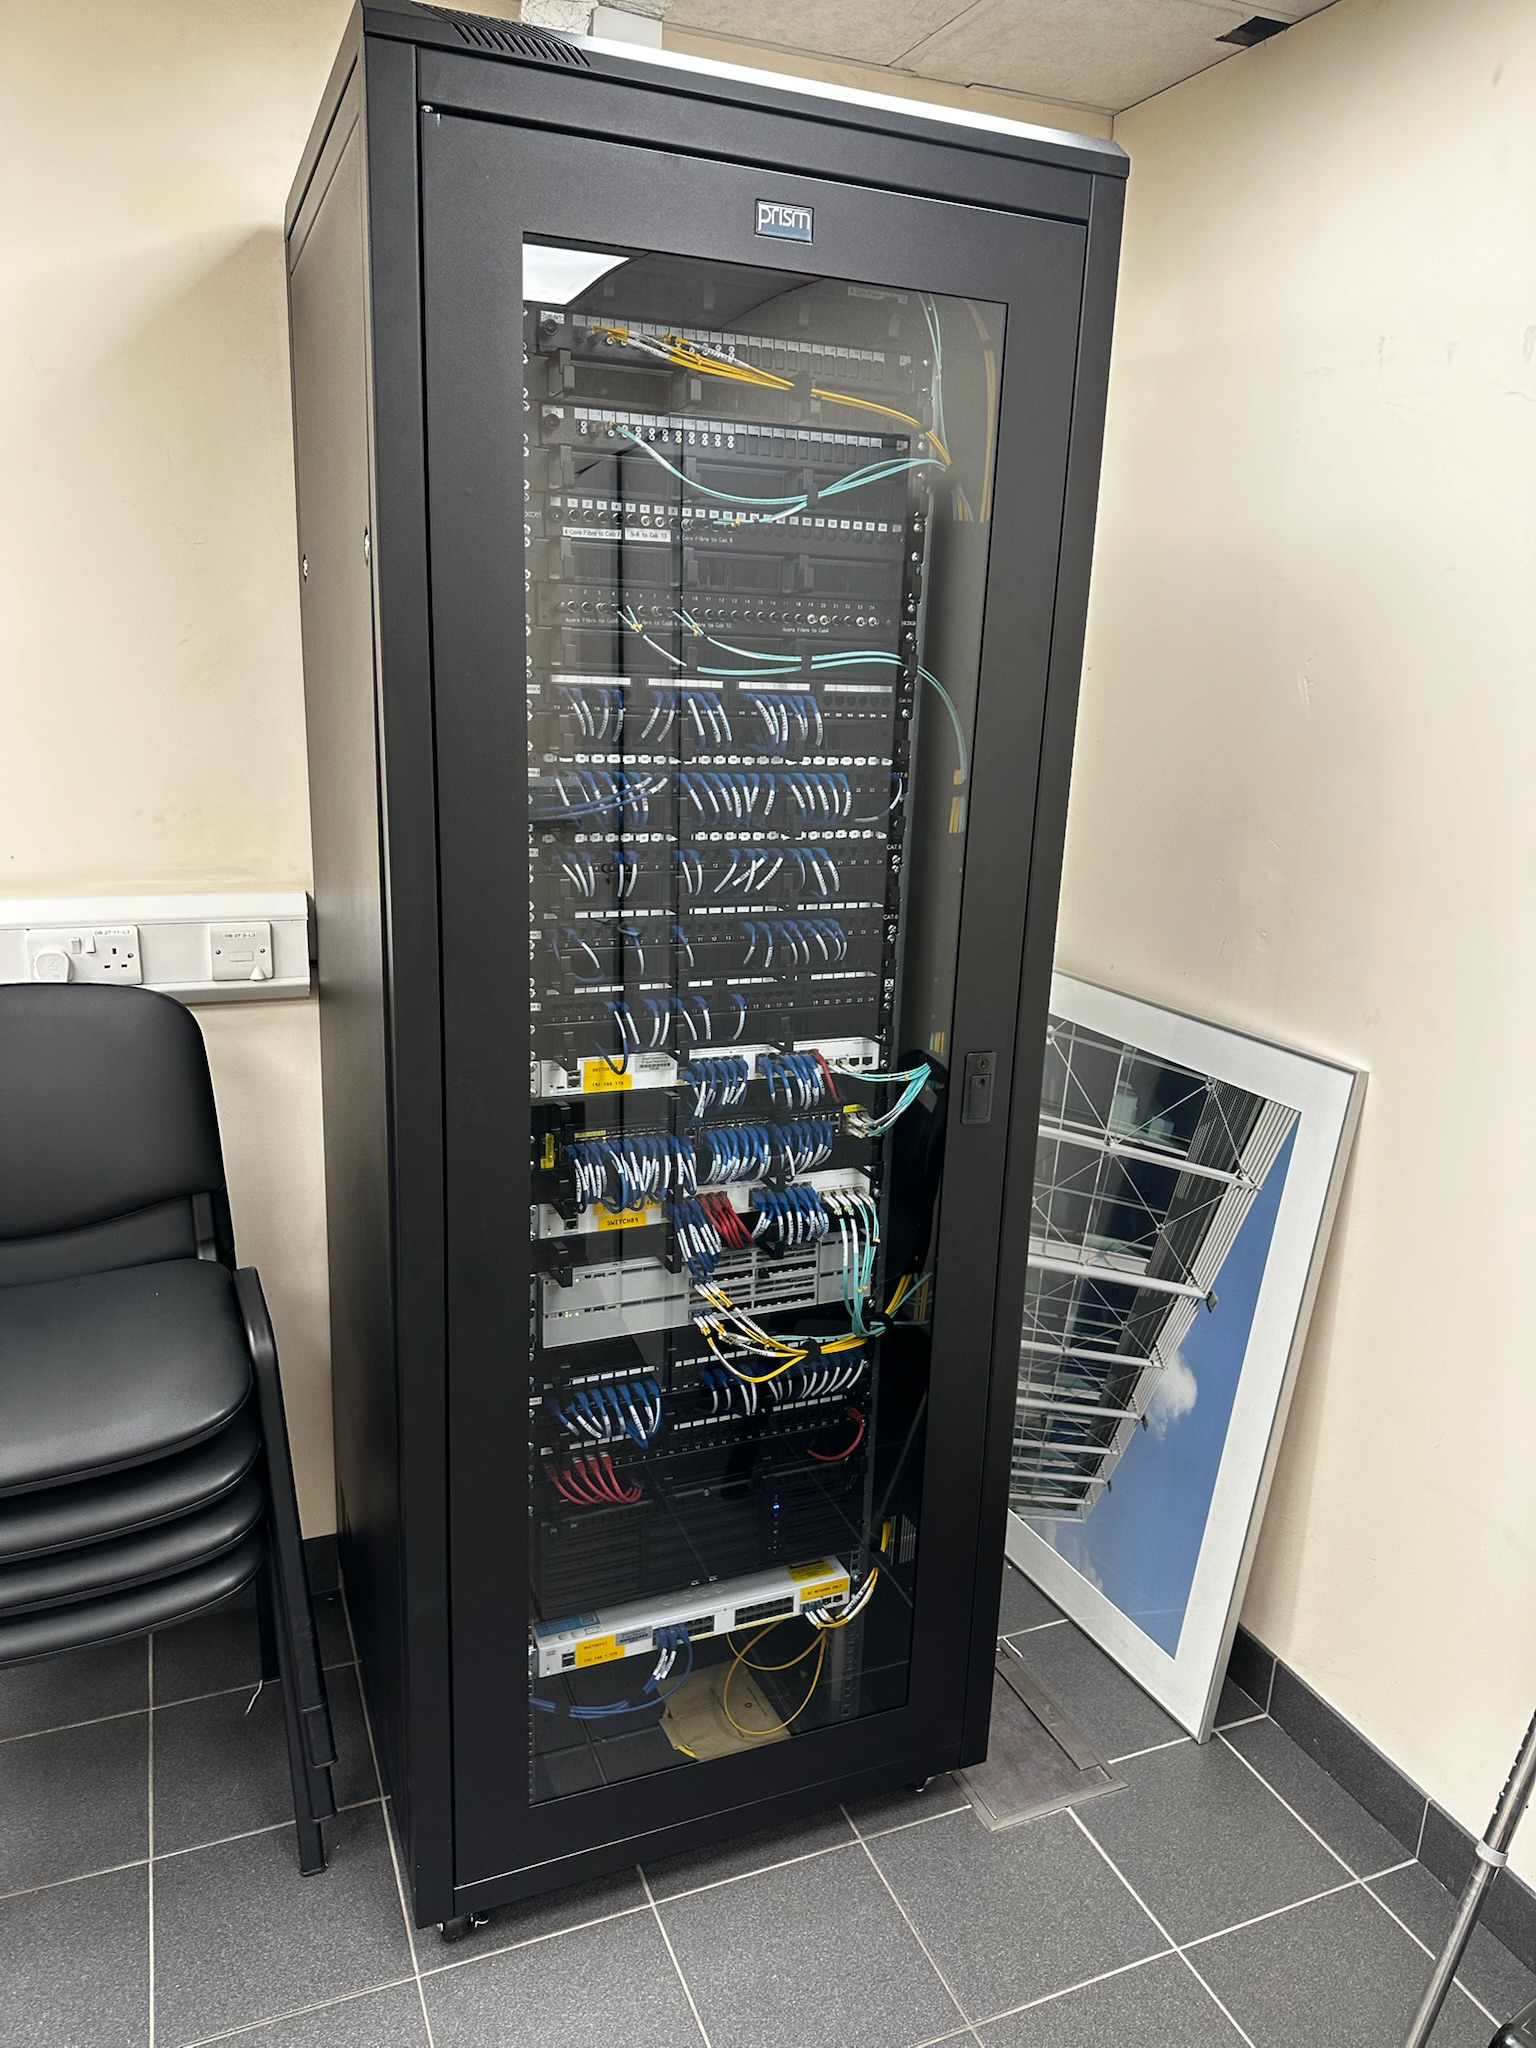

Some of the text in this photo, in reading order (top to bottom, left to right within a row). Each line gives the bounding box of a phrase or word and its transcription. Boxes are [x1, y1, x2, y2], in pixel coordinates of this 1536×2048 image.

[758, 203, 810, 230] prism
[524, 509, 542, 519] xcel
[606, 1217, 639, 1227] SWITCH89
